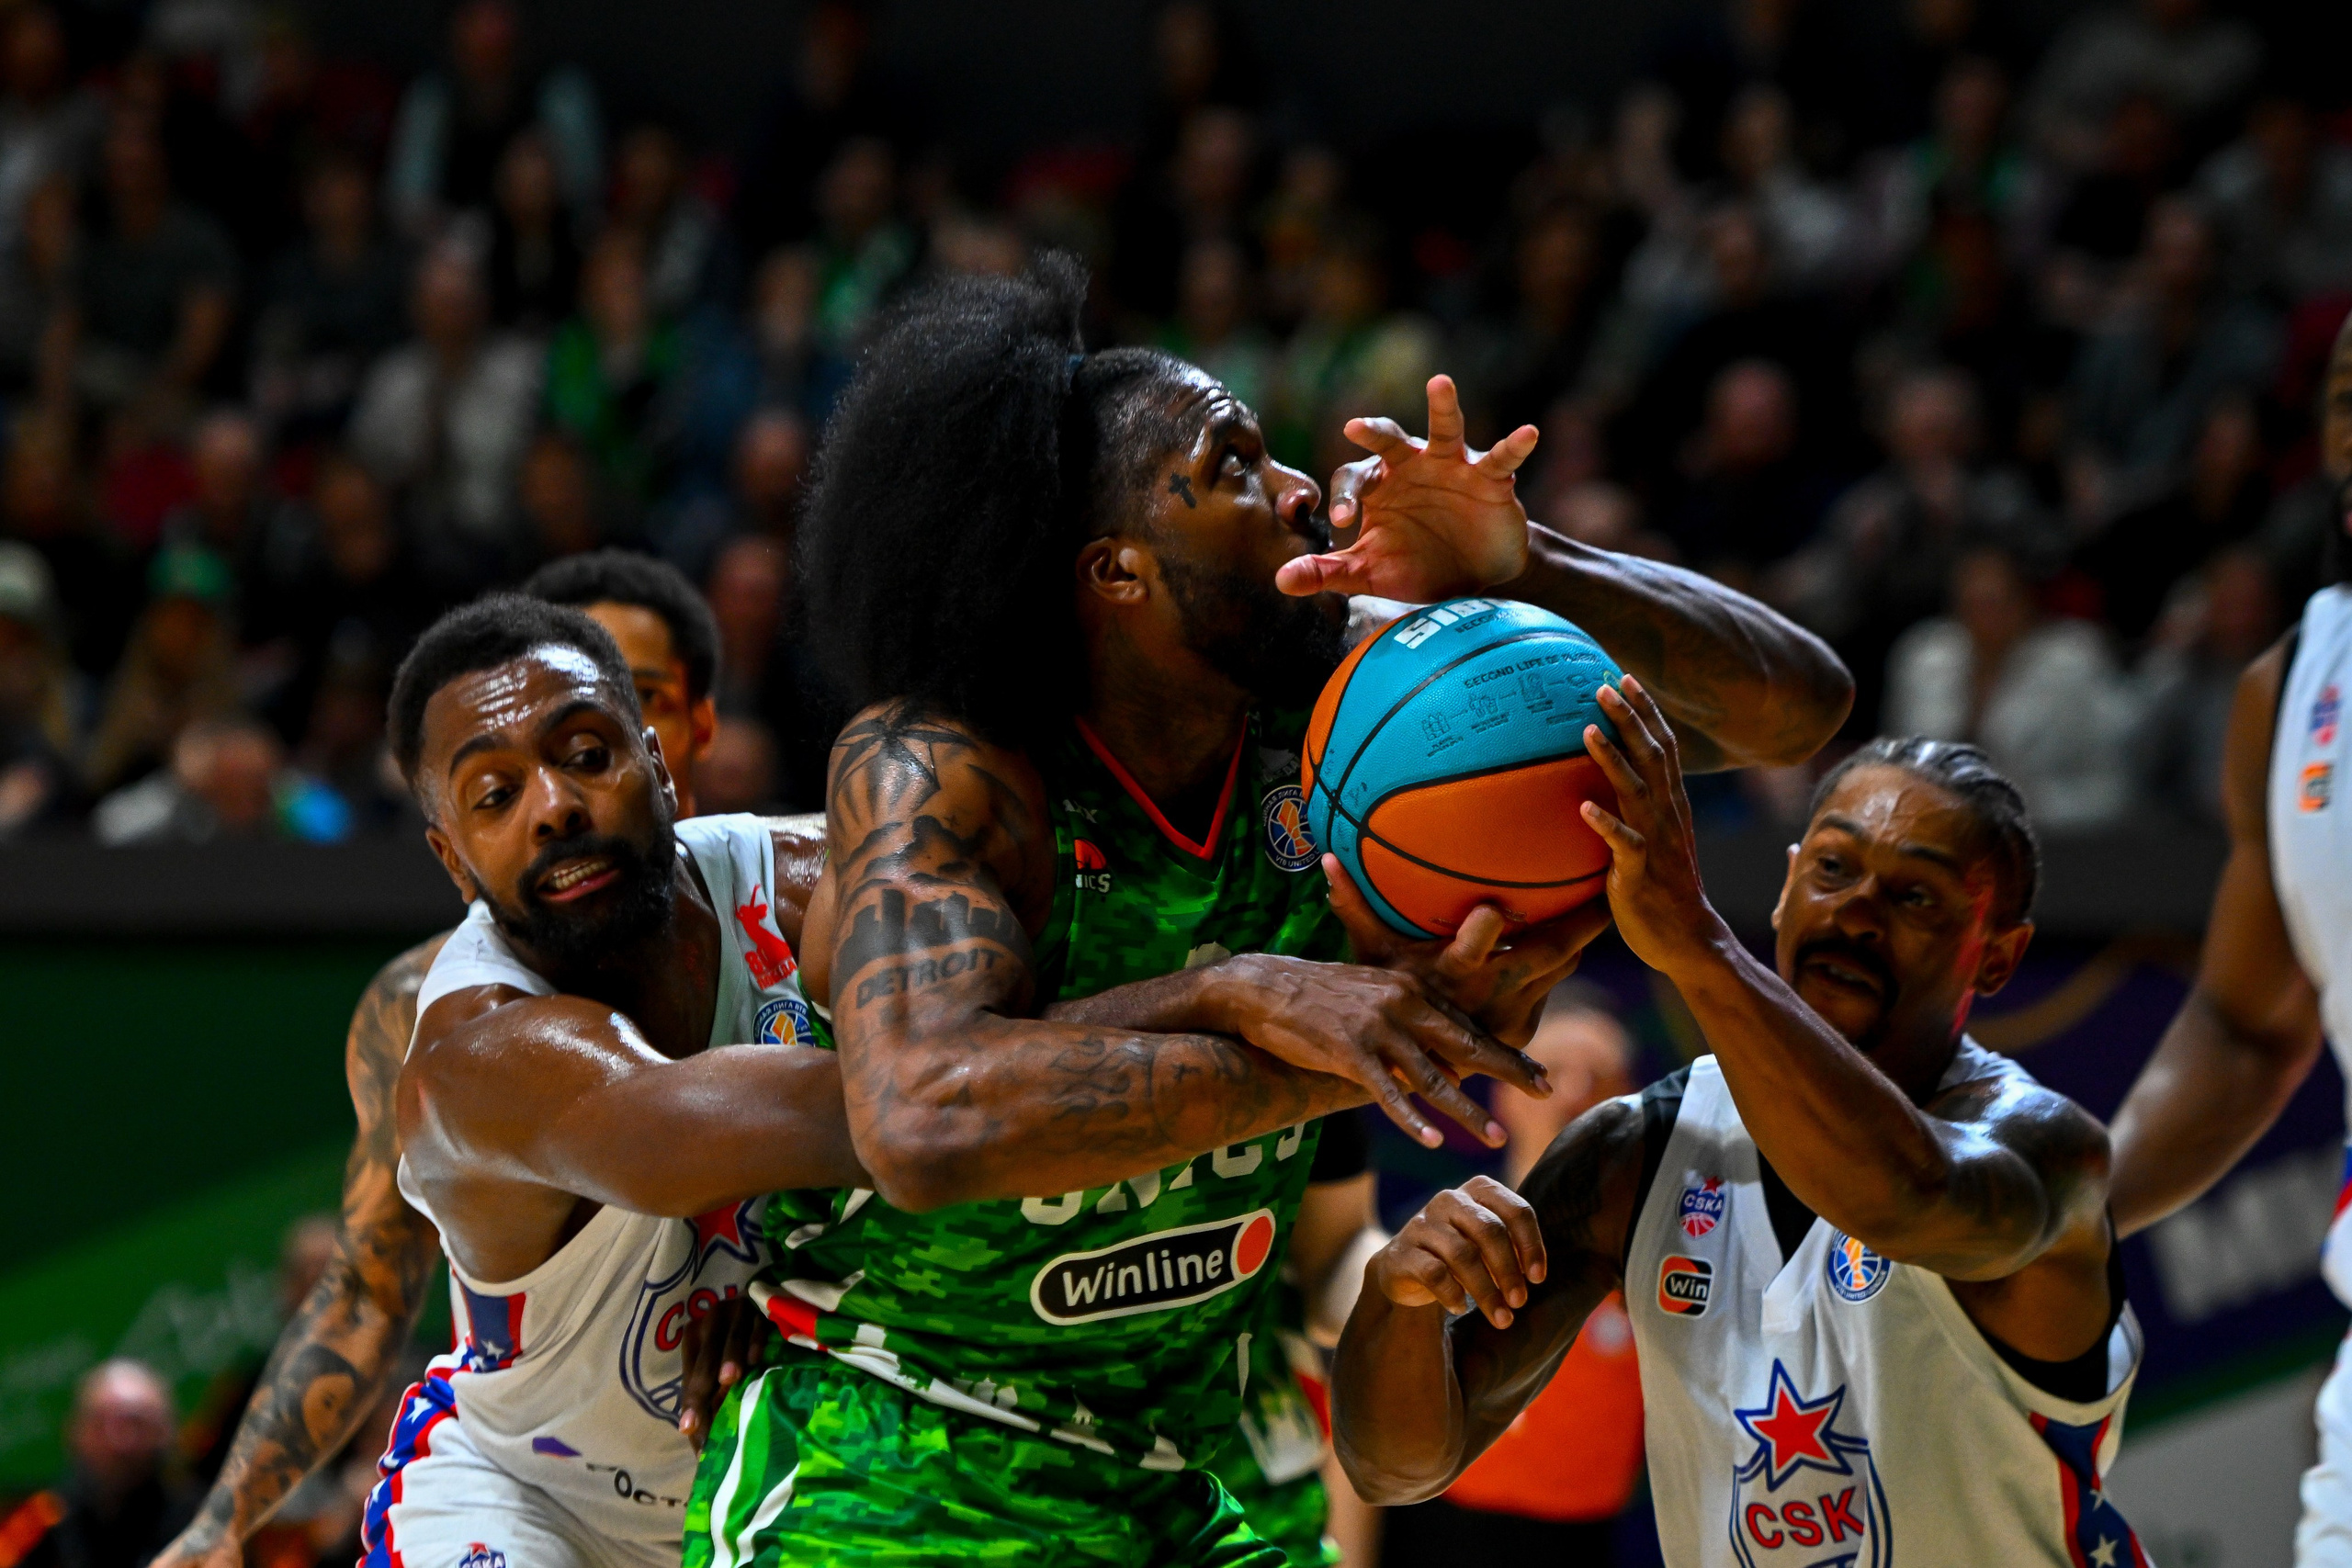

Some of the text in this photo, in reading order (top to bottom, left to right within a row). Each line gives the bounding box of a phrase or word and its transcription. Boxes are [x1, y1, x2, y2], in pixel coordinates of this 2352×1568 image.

[1464, 664, 1515, 689] SECOND
[1517, 657, 1544, 671] LIFE
[1287, 852, 1316, 868] UNITED
[856, 948, 1004, 1009] DETROIT
[1683, 1193, 1724, 1213] CSKA
[1062, 1249, 1225, 1308] Winline
[1669, 1277, 1708, 1300] Win
